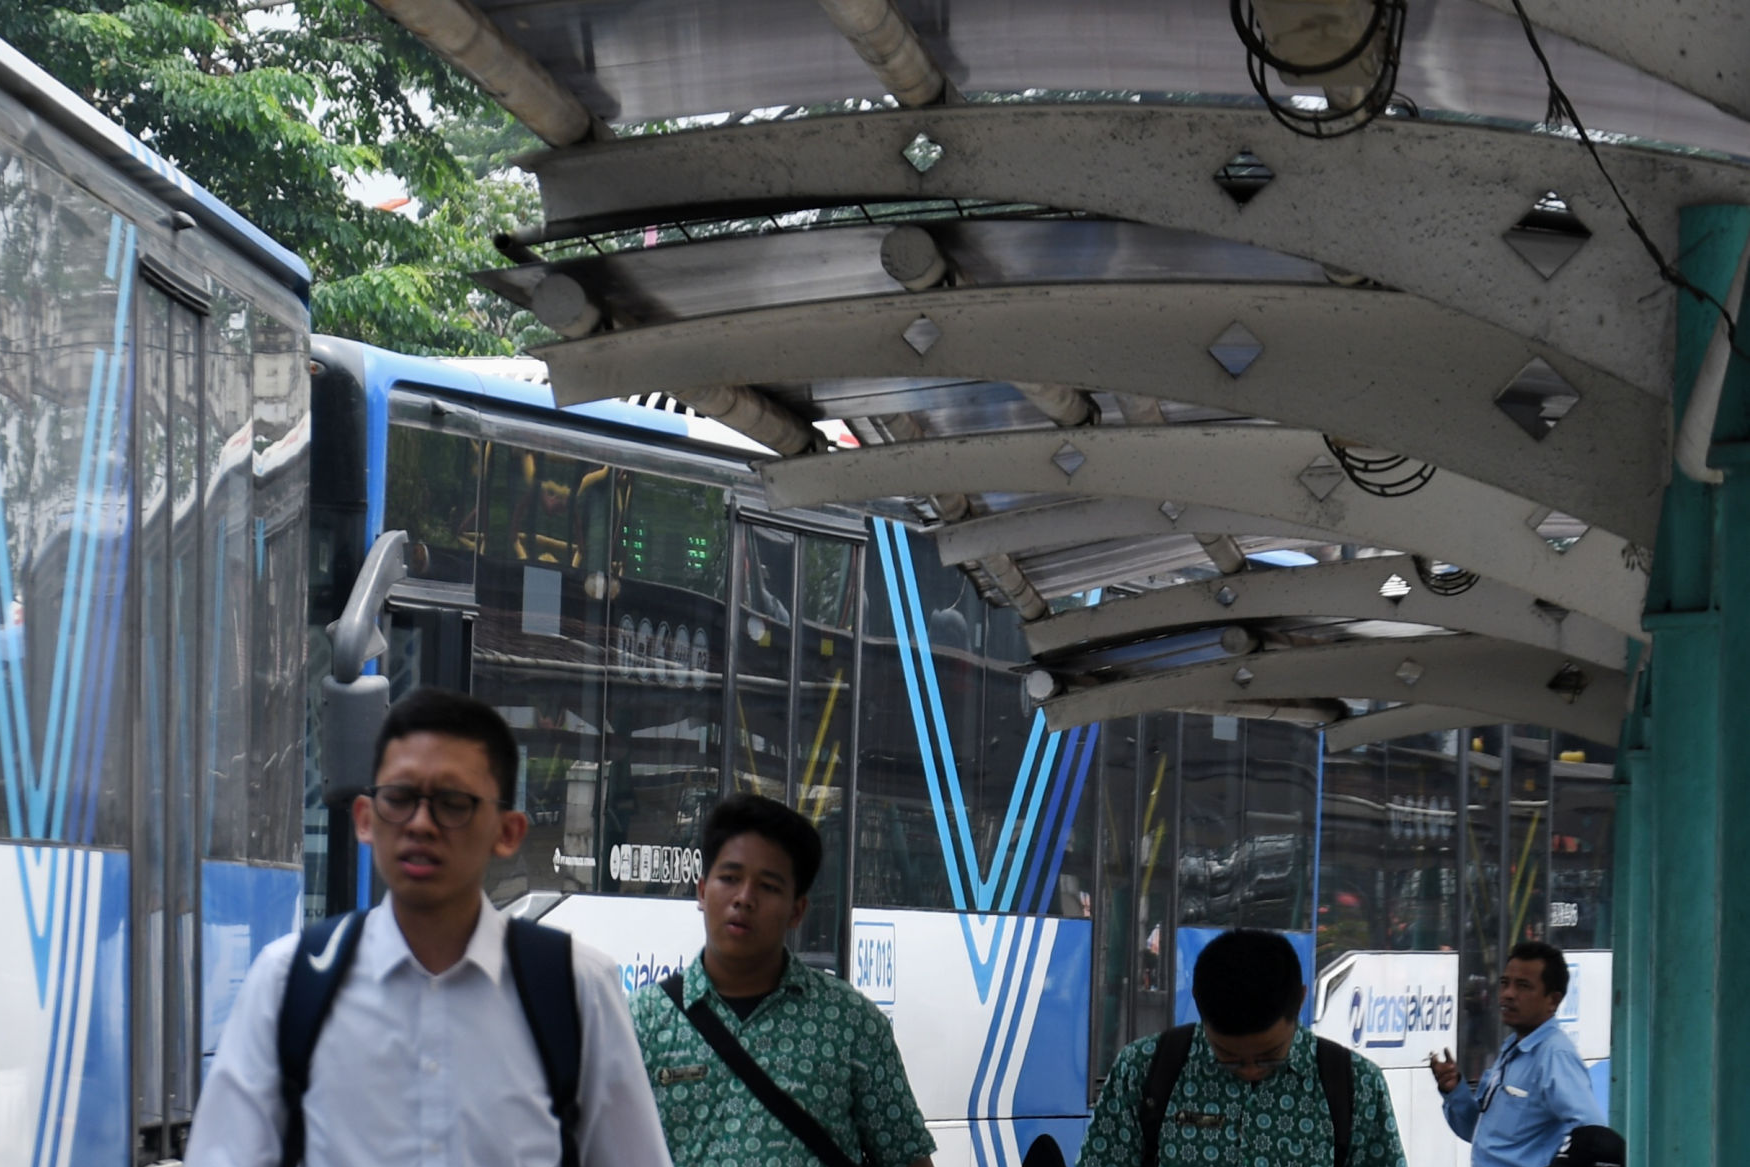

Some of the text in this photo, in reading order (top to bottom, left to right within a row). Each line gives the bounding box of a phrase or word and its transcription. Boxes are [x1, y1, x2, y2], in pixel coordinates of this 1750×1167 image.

[857, 938, 893, 988] SAF 018
[1366, 984, 1454, 1040] transjakarta
